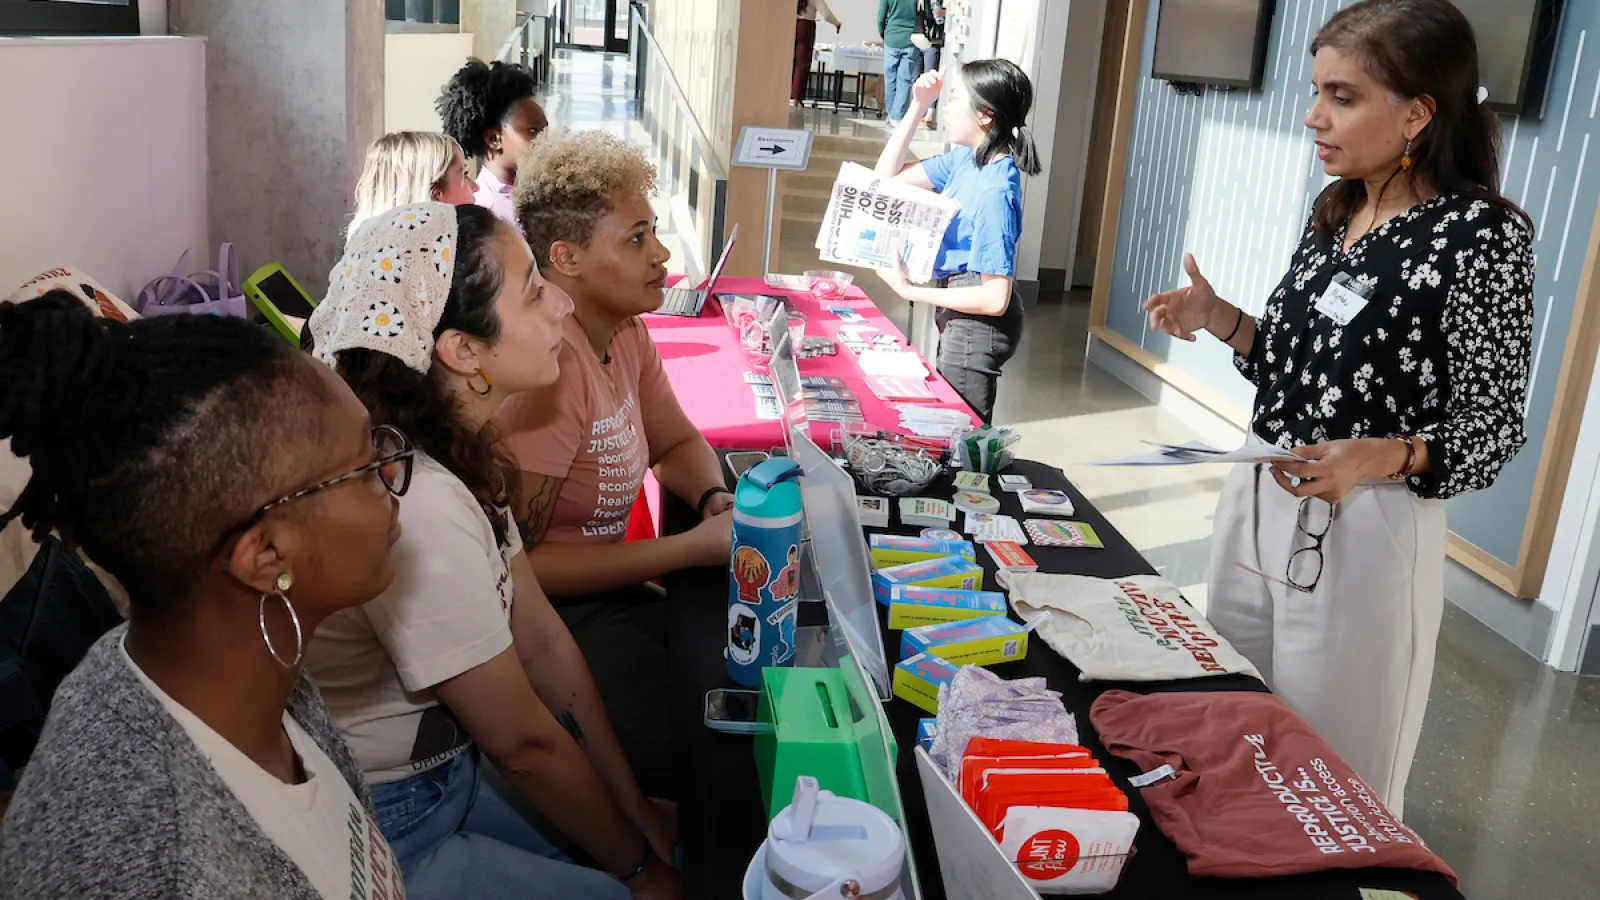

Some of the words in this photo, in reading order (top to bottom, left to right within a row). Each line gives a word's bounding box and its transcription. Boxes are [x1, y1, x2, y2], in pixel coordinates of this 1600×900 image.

[598, 466, 627, 478] birth
[904, 590, 965, 605] Julie
[1309, 757, 1347, 797] access
[1306, 795, 1376, 854] JUSTICE
[1026, 838, 1053, 871] AUNT
